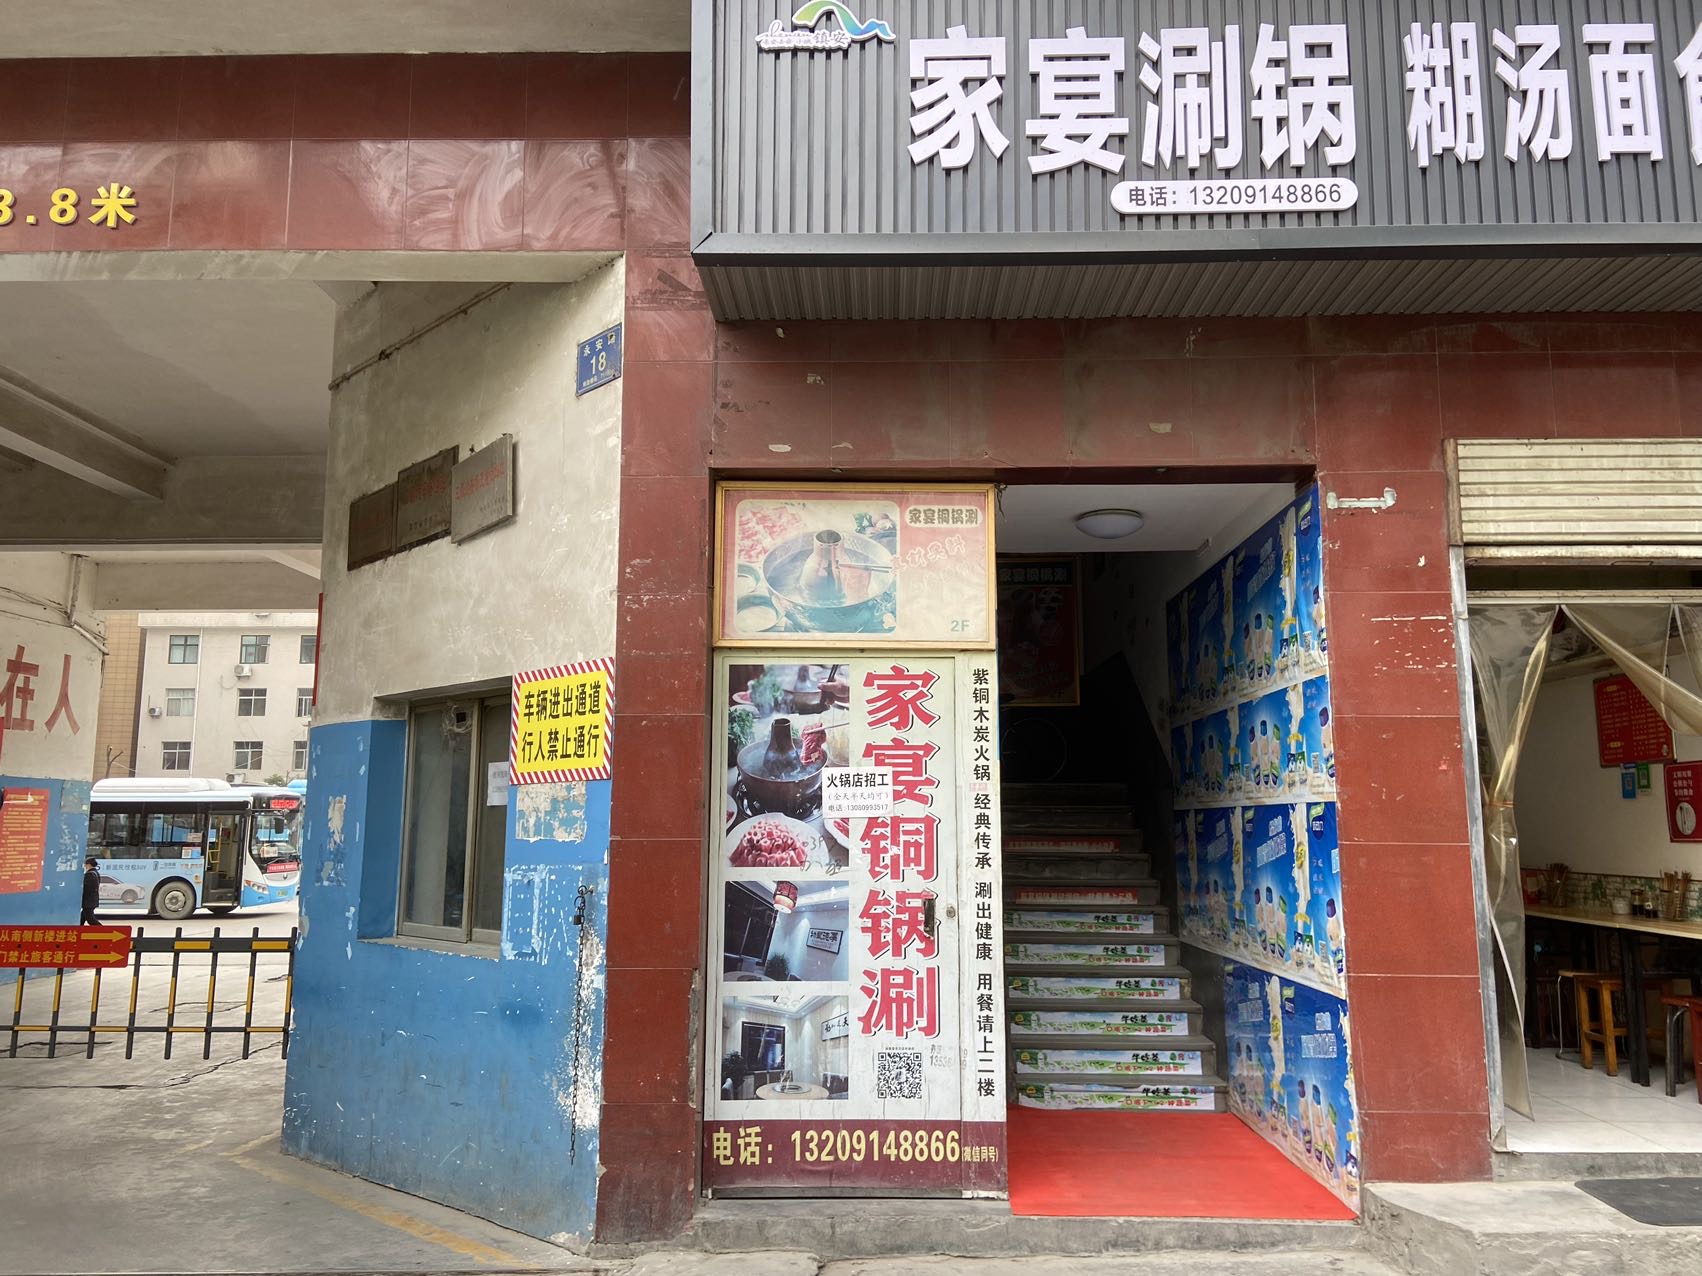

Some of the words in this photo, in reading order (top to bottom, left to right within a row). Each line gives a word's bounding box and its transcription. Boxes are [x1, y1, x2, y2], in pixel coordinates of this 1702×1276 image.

[907, 24, 1356, 174] 家宴涮锅
[590, 351, 606, 375] 18
[908, 508, 978, 525] 家宴铜锅涮
[950, 619, 970, 633] 2F
[523, 680, 602, 723] 车辆进出通道
[972, 668, 991, 781] 紫铜木炭火锅
[521, 724, 600, 764] 行人禁止通行
[827, 773, 889, 788] 火锅店招工
[858, 664, 941, 1039] 家宴铜锅涮
[974, 793, 992, 869] 经典传承
[974, 881, 993, 961] 涮出健康
[976, 973, 996, 1097] 用餐请上二楼
